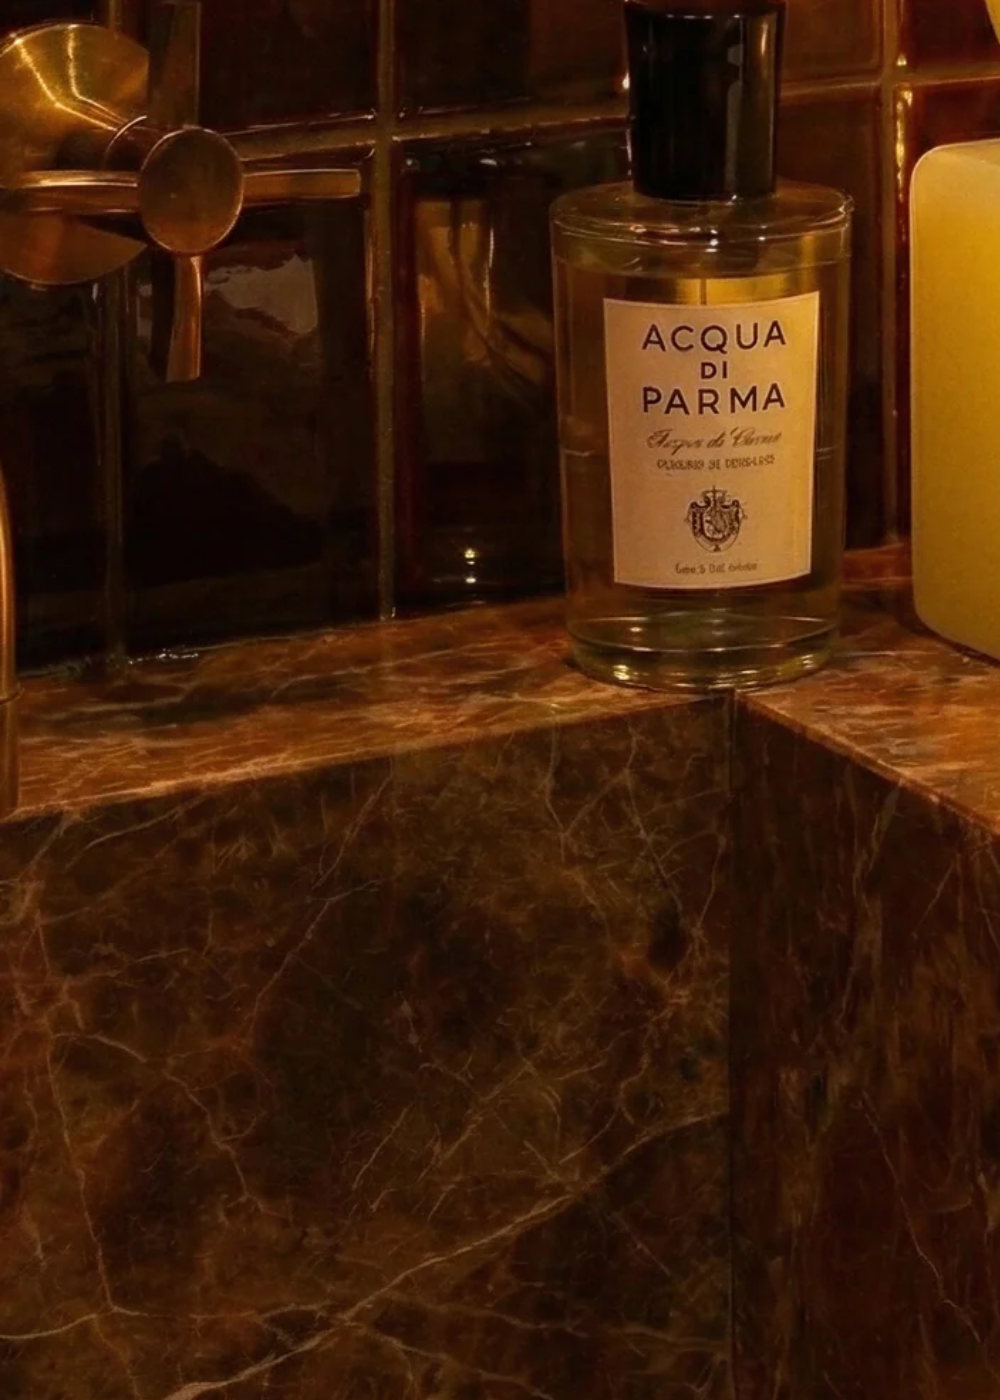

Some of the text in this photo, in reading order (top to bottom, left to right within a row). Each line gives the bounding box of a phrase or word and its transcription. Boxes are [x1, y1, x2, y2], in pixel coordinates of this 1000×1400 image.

[642, 320, 786, 354] ACQUA
[701, 361, 728, 379] DI
[642, 383, 785, 415] PARMA
